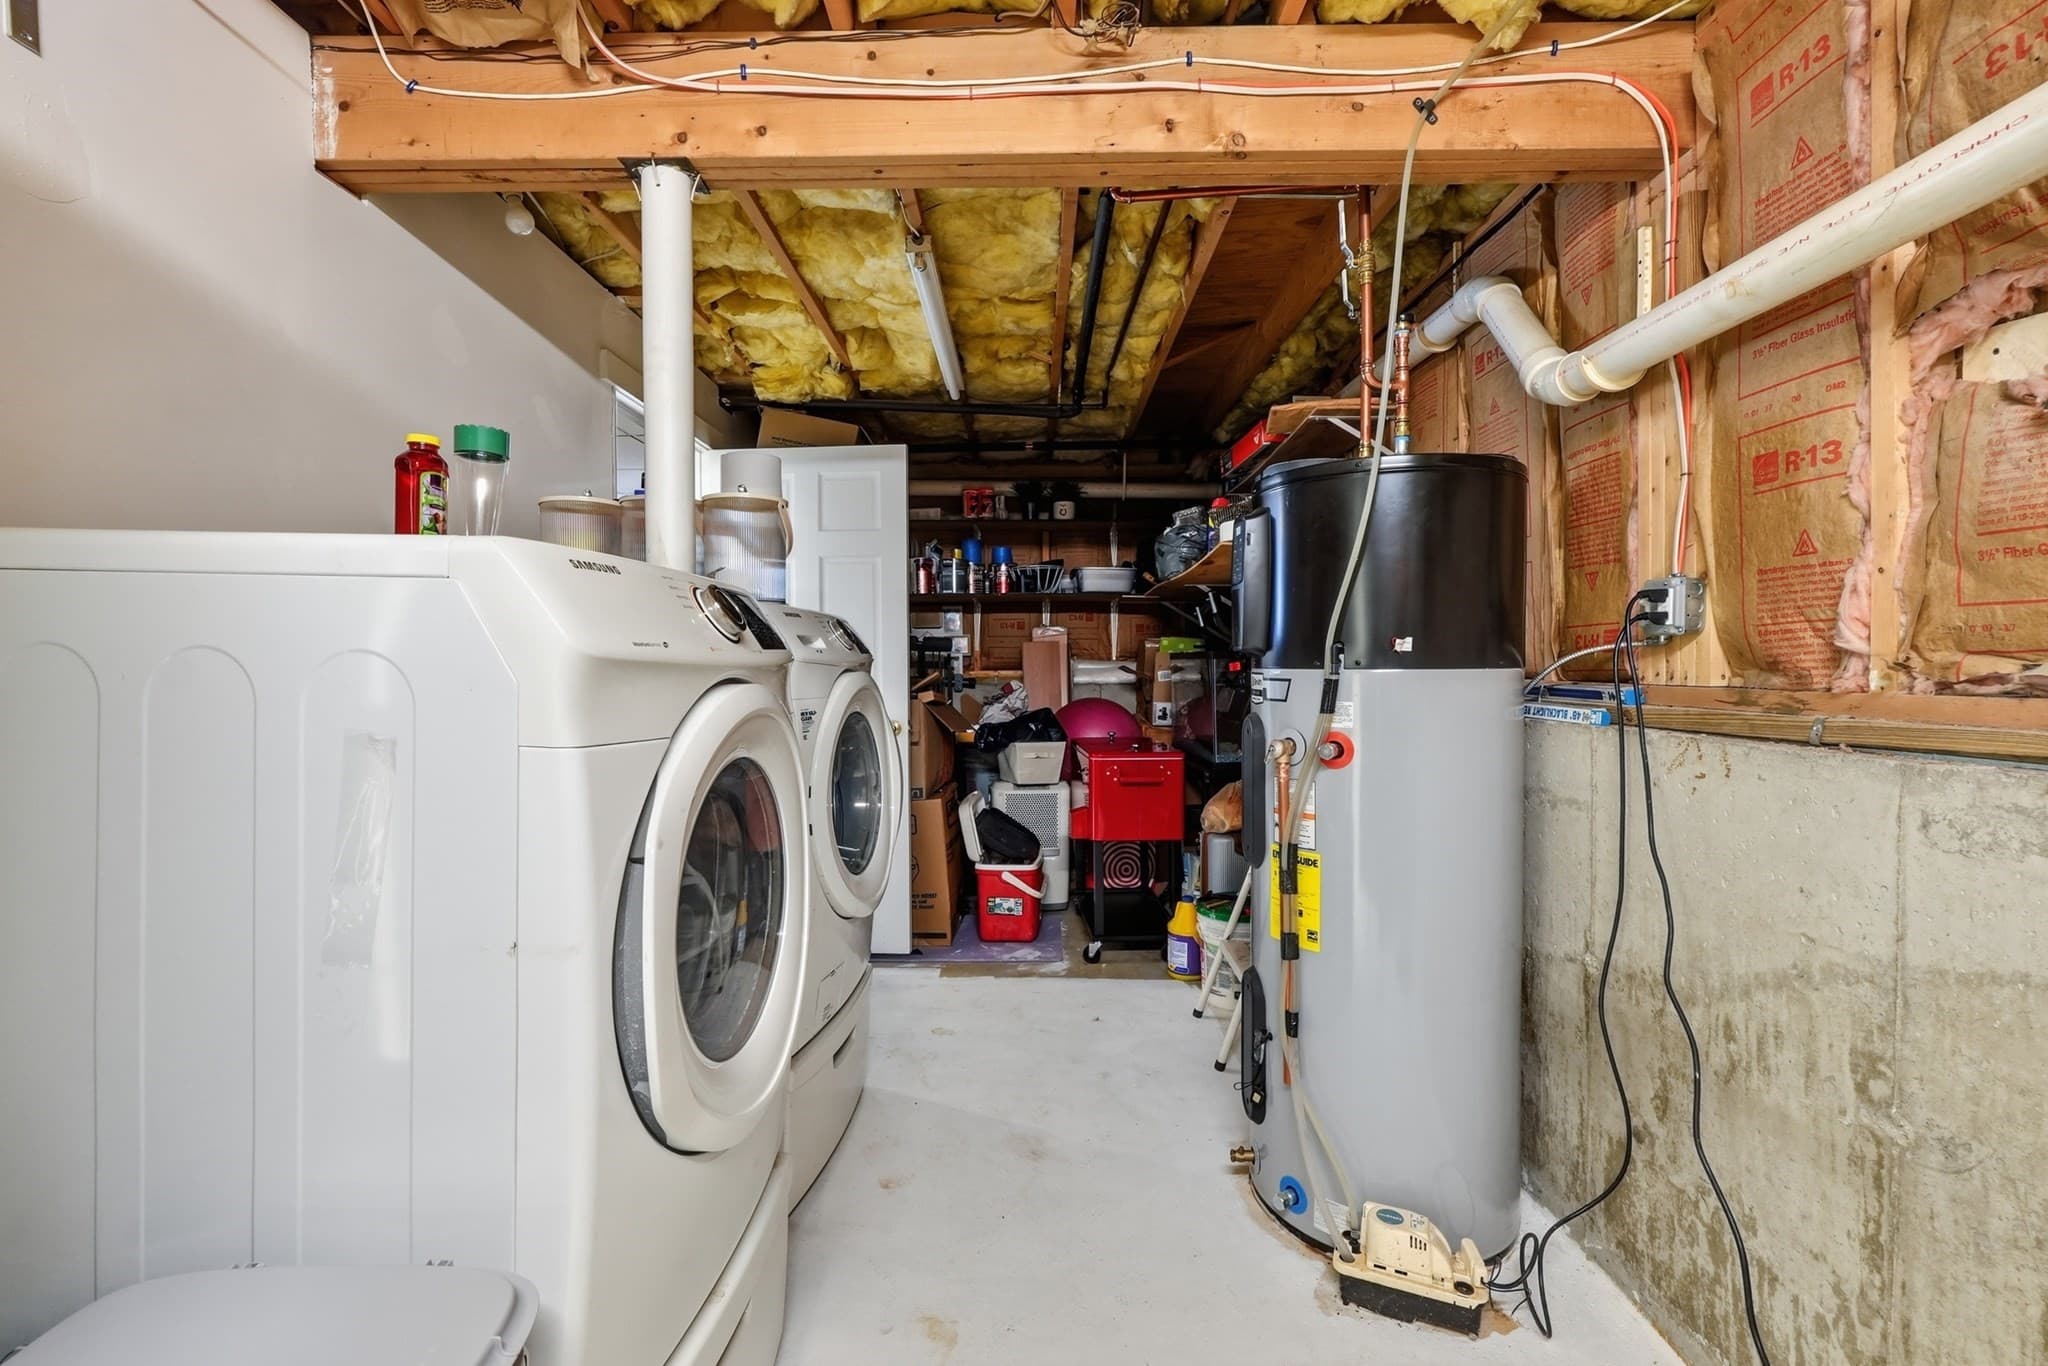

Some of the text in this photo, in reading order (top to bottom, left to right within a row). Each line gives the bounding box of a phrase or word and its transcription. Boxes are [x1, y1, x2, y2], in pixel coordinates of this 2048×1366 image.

[1779, 34, 1831, 91] R-13
[1884, 114, 2028, 198] CHARLOTTE
[1768, 338, 1788, 352] Fiber
[1790, 326, 1816, 343] Glass
[1816, 308, 1857, 333] Insulatio
[1785, 439, 1843, 475] R-13
[568, 558, 622, 576] SAMSUNG
[2003, 545, 2035, 559] Fiber
[1533, 706, 1569, 719] BLACKLIGHT
